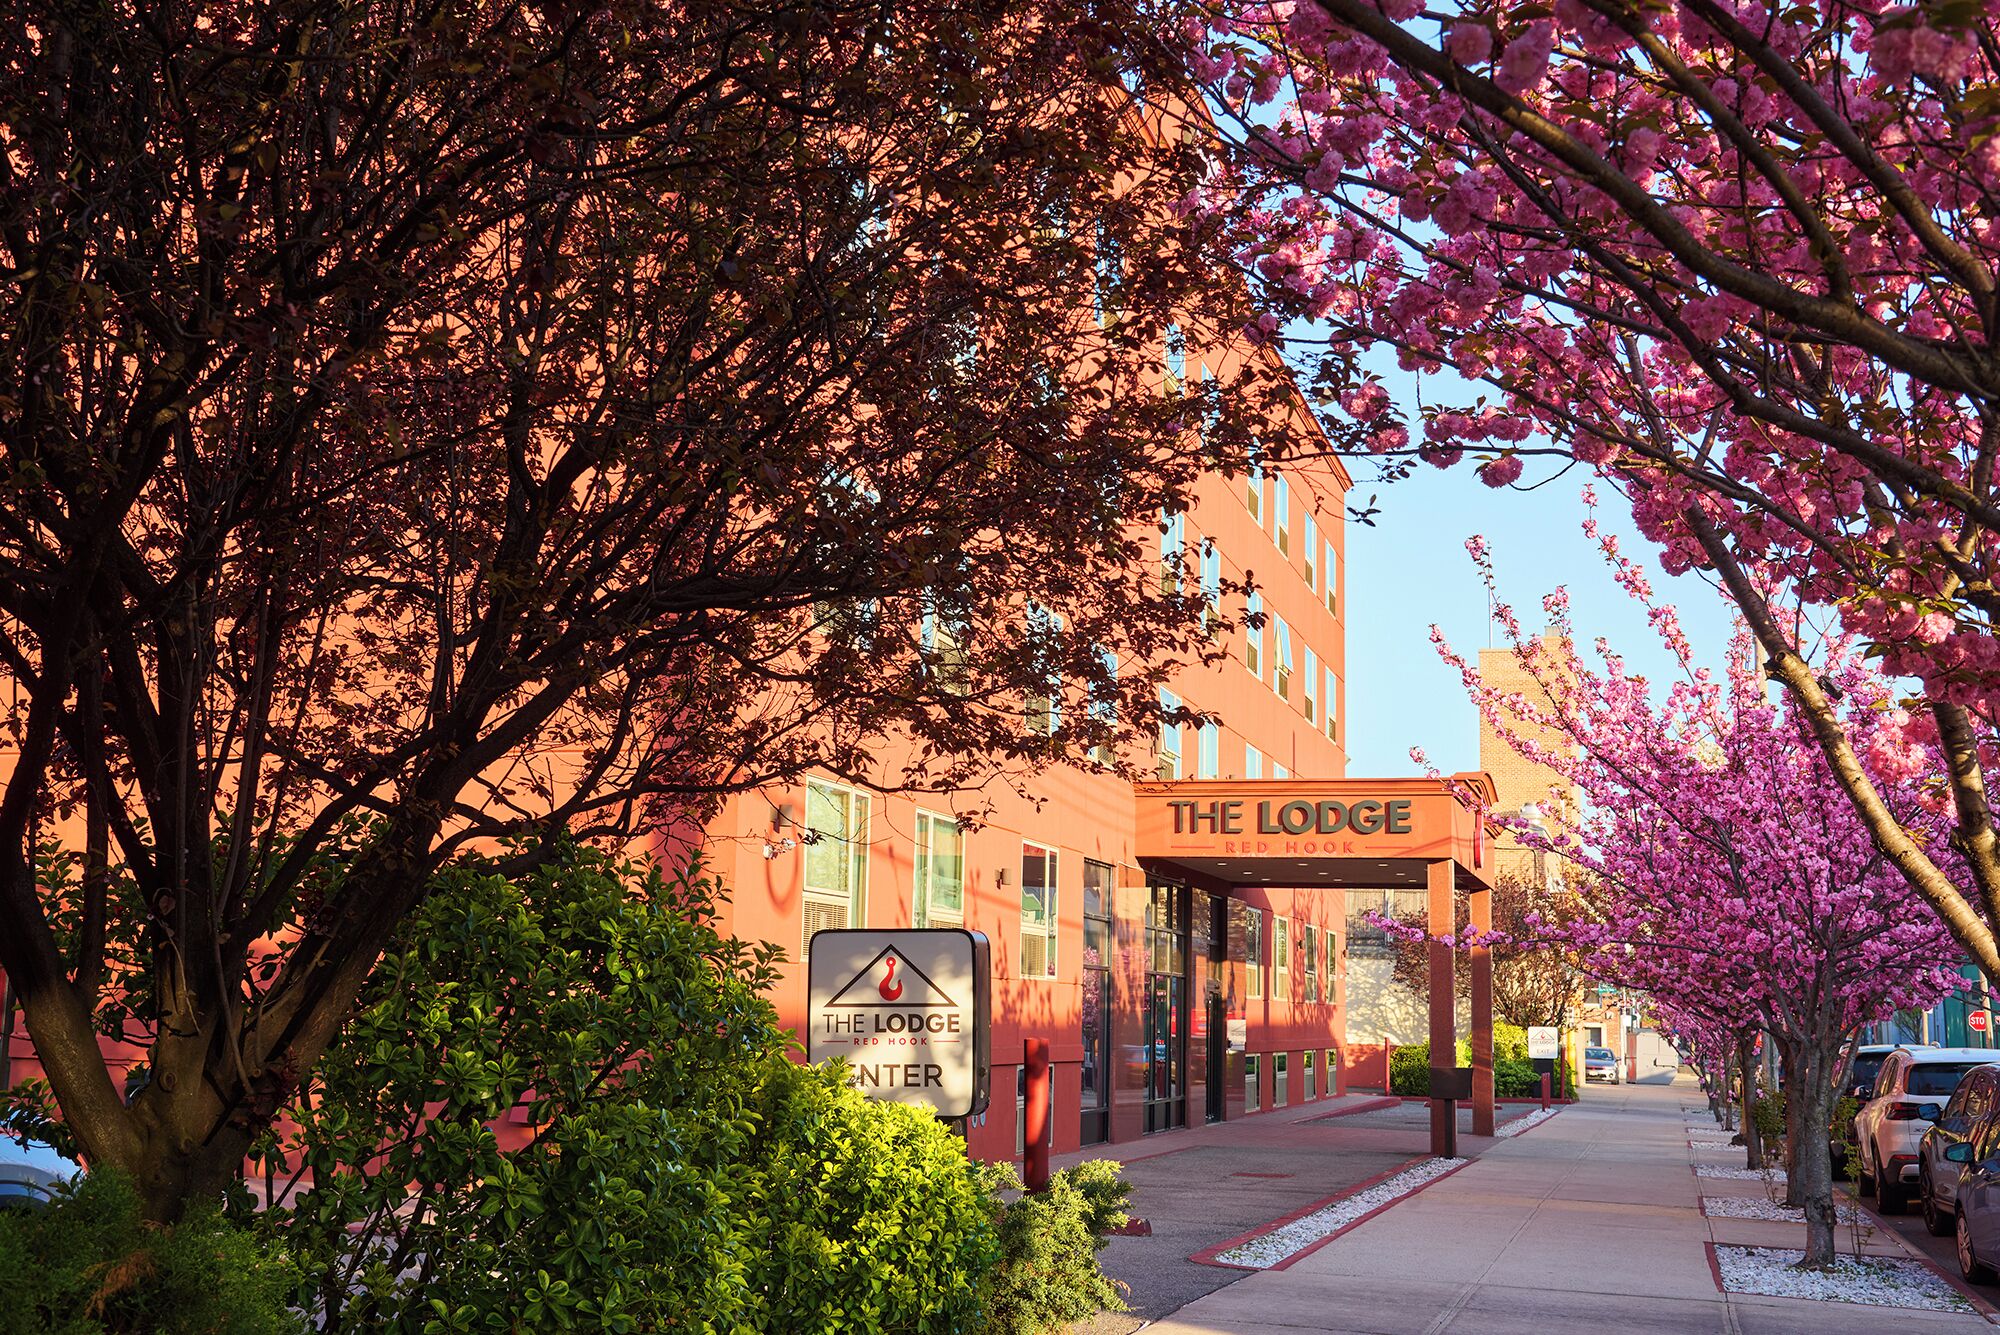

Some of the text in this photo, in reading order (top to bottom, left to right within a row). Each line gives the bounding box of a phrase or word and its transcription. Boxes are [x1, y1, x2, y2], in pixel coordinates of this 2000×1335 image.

[1167, 799, 1412, 835] THE LODGE
[1225, 841, 1356, 854] RED HOOK
[822, 1013, 960, 1033] THE LODGE
[1970, 1017, 1985, 1025] STO
[853, 1037, 928, 1046] RED HOOK
